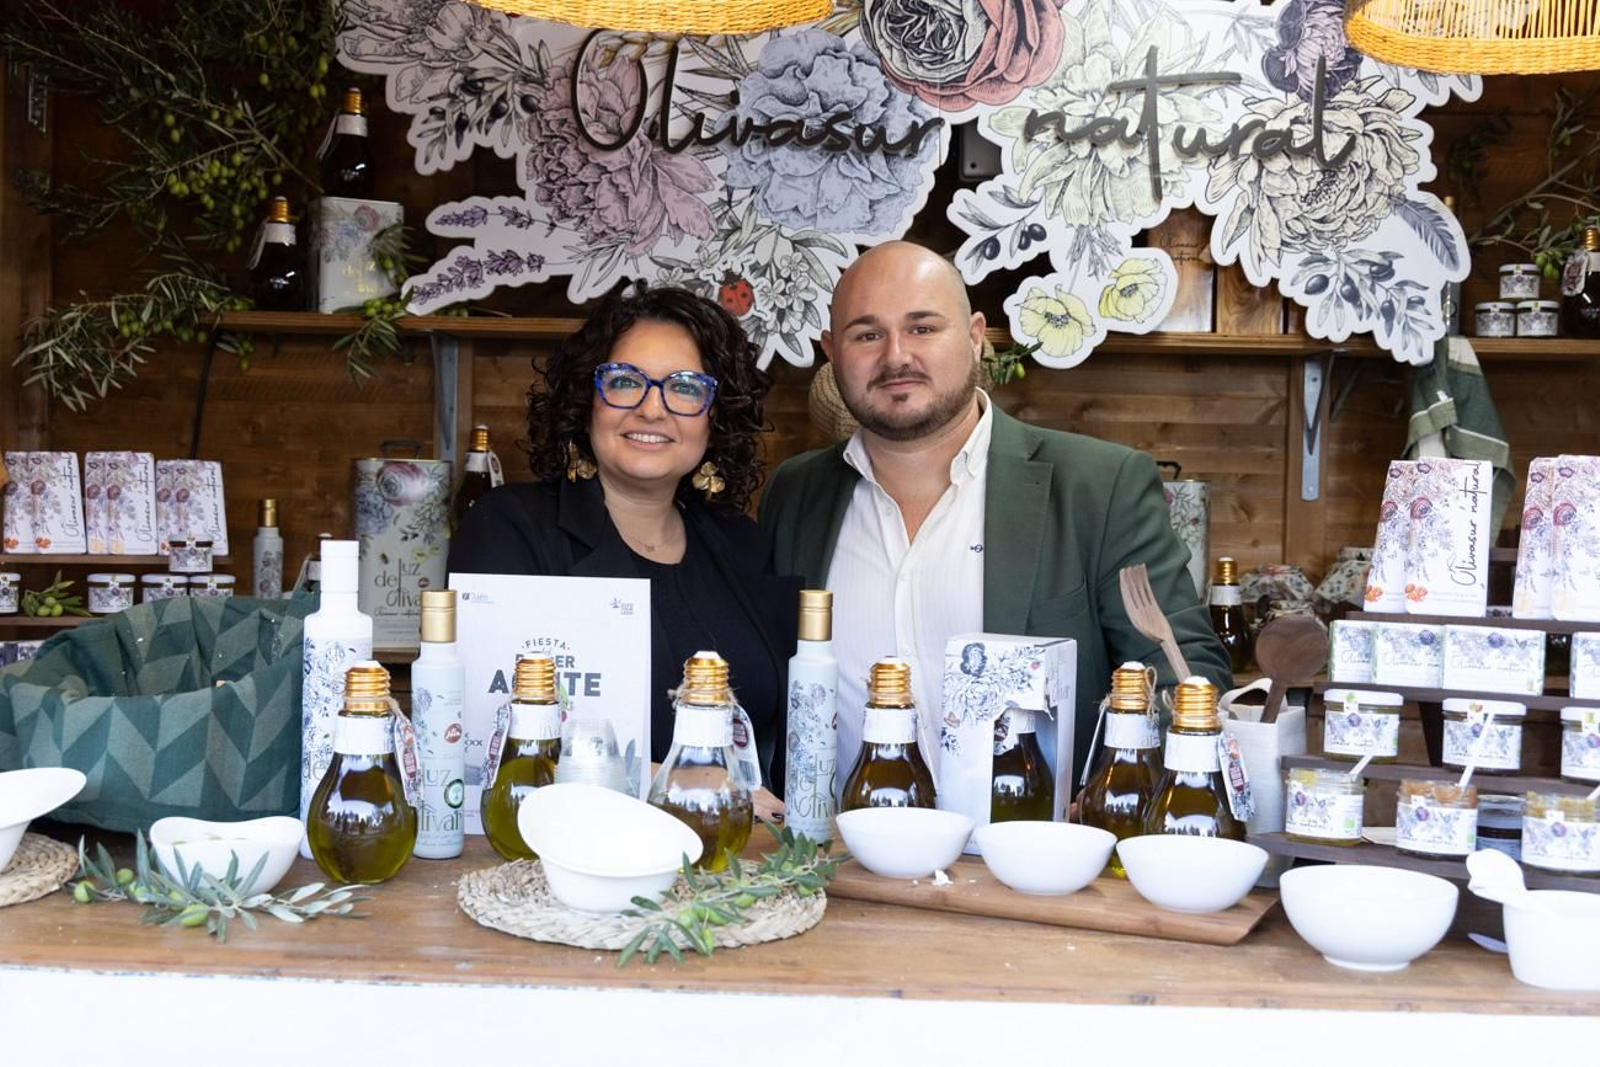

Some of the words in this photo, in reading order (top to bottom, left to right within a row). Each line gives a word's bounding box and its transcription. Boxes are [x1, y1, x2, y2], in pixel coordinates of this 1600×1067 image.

[571, 28, 945, 157] Olivasur
[1023, 45, 1356, 201] natural
[1459, 462, 1487, 514] natural
[1451, 519, 1478, 586] Olivasur
[525, 637, 567, 650] FIESTA
[488, 669, 602, 697] AITE
